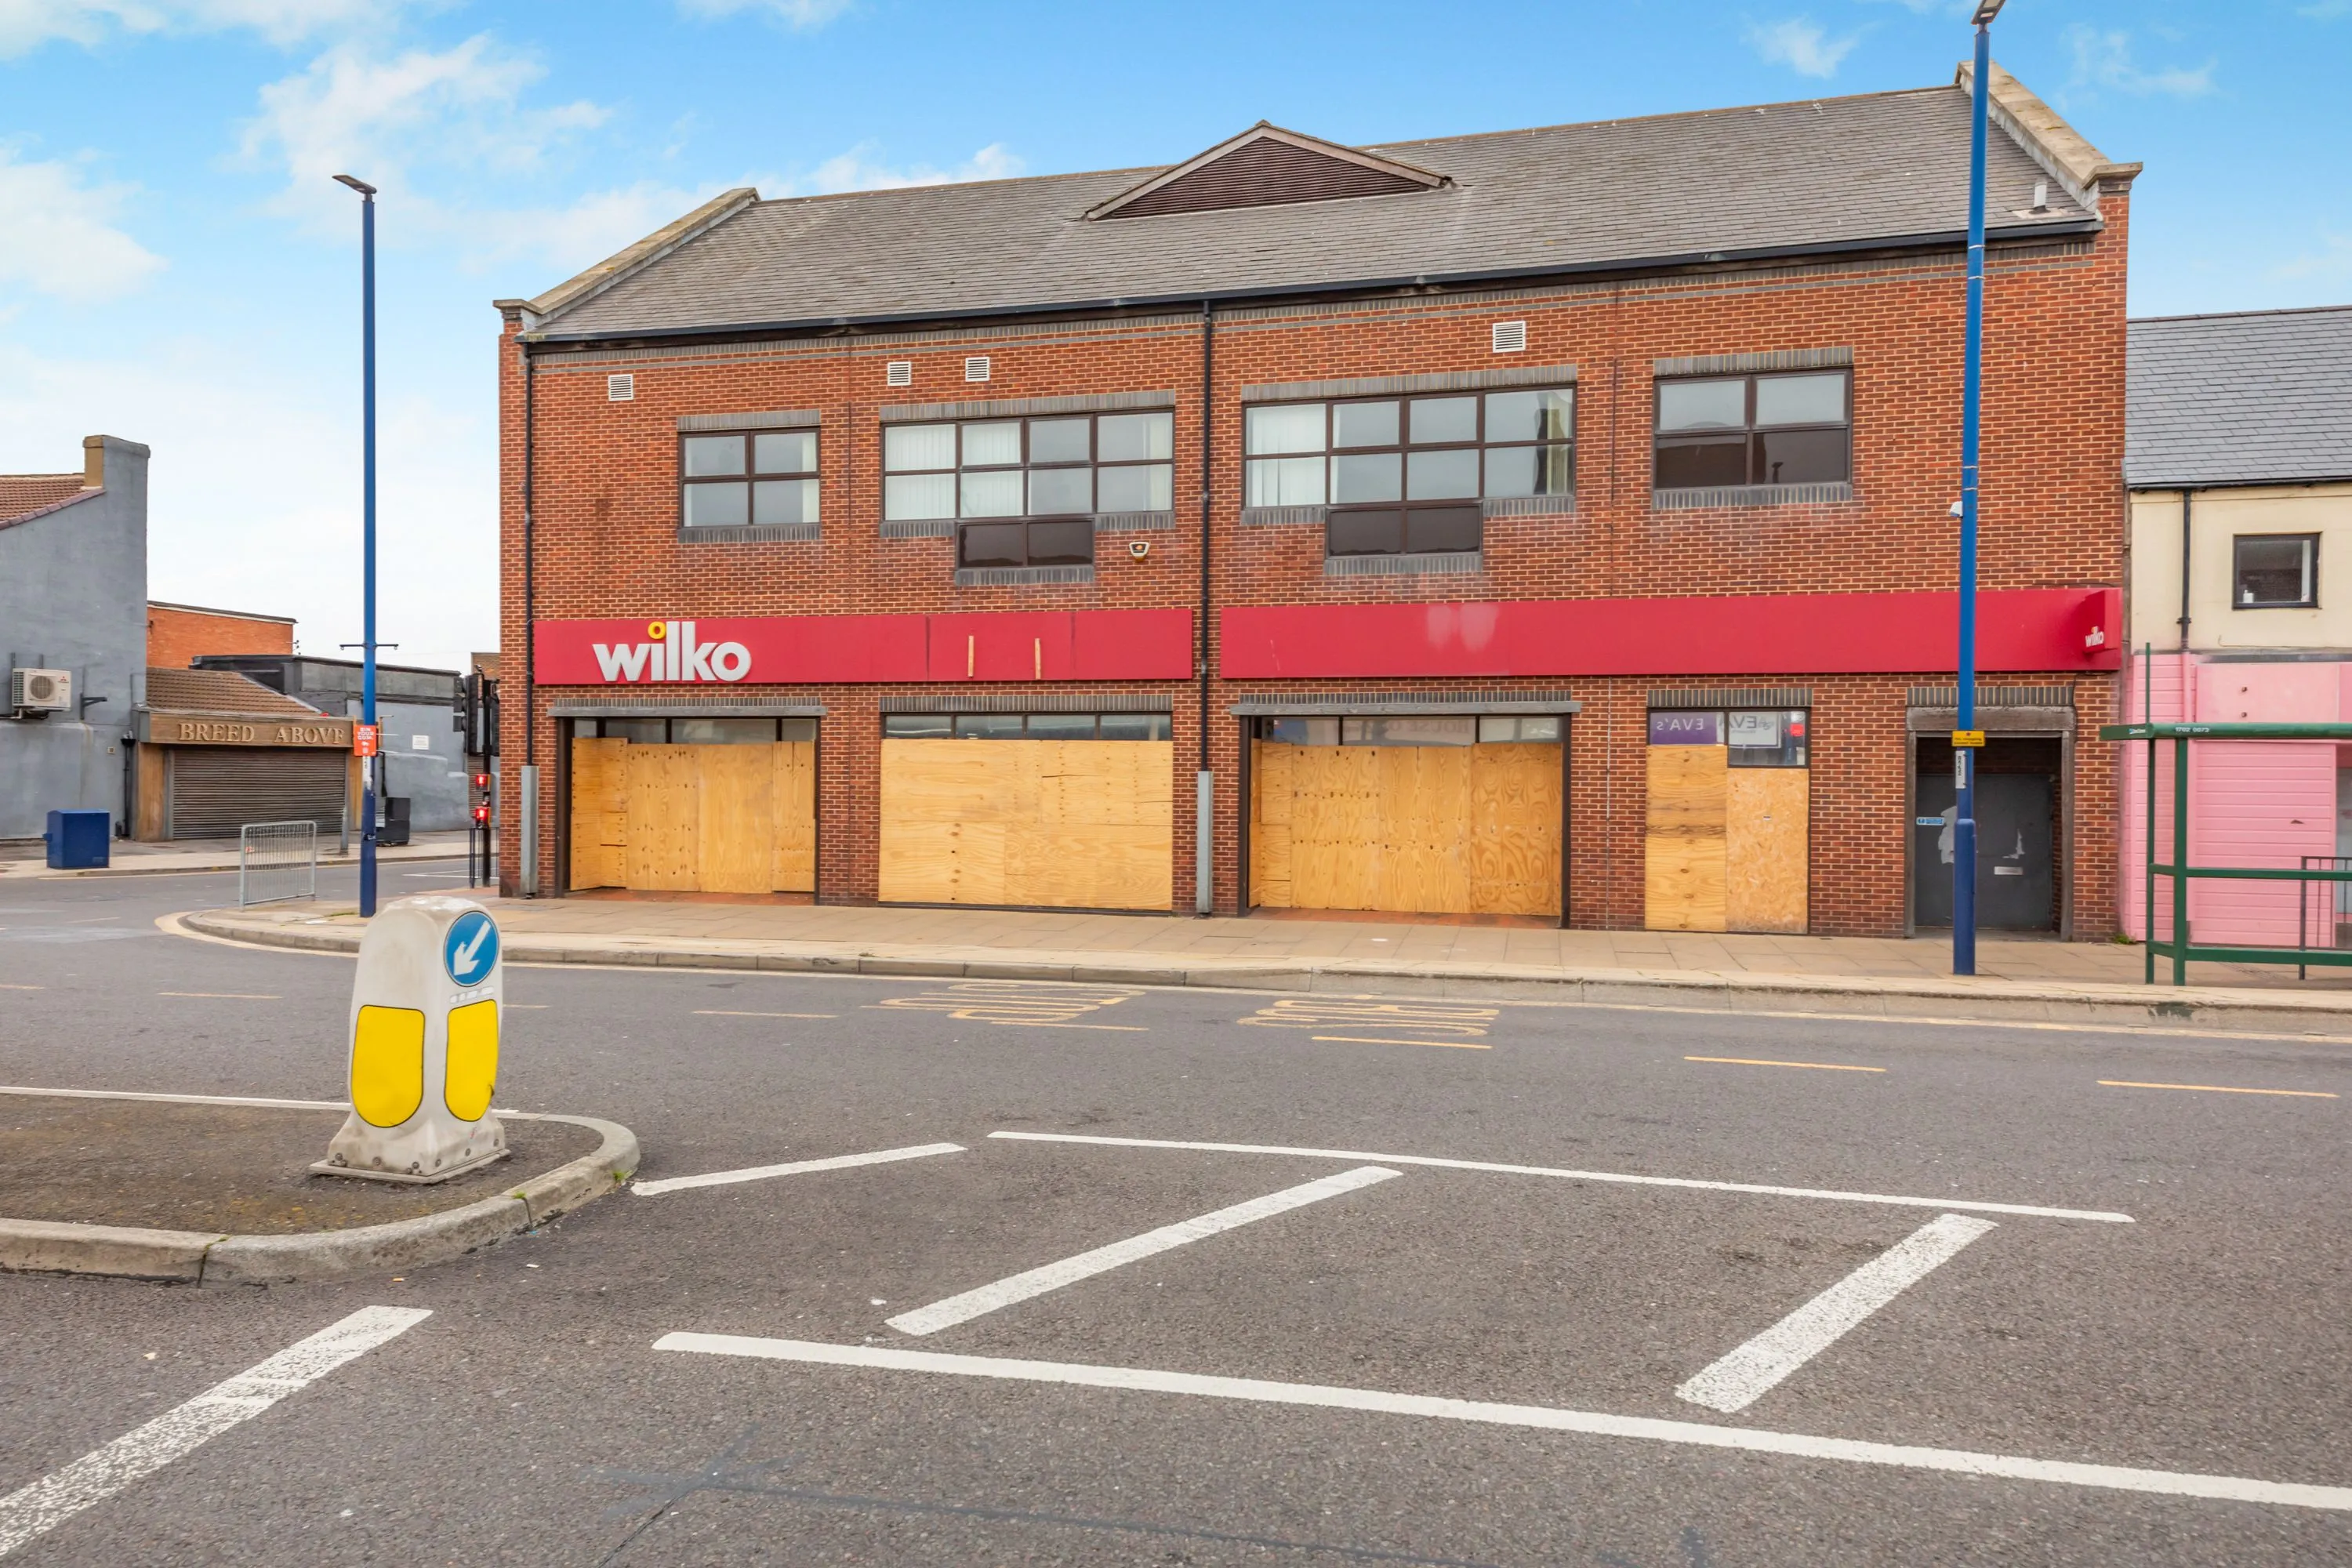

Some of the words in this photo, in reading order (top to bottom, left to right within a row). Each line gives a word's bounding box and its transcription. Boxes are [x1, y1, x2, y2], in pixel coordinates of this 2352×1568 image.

[592, 621, 752, 682] wilko
[2085, 626, 2104, 648] wilko
[179, 723, 255, 742] BREED
[859, 983, 1147, 1022] STOP
[1236, 1000, 1500, 1036] BUS
